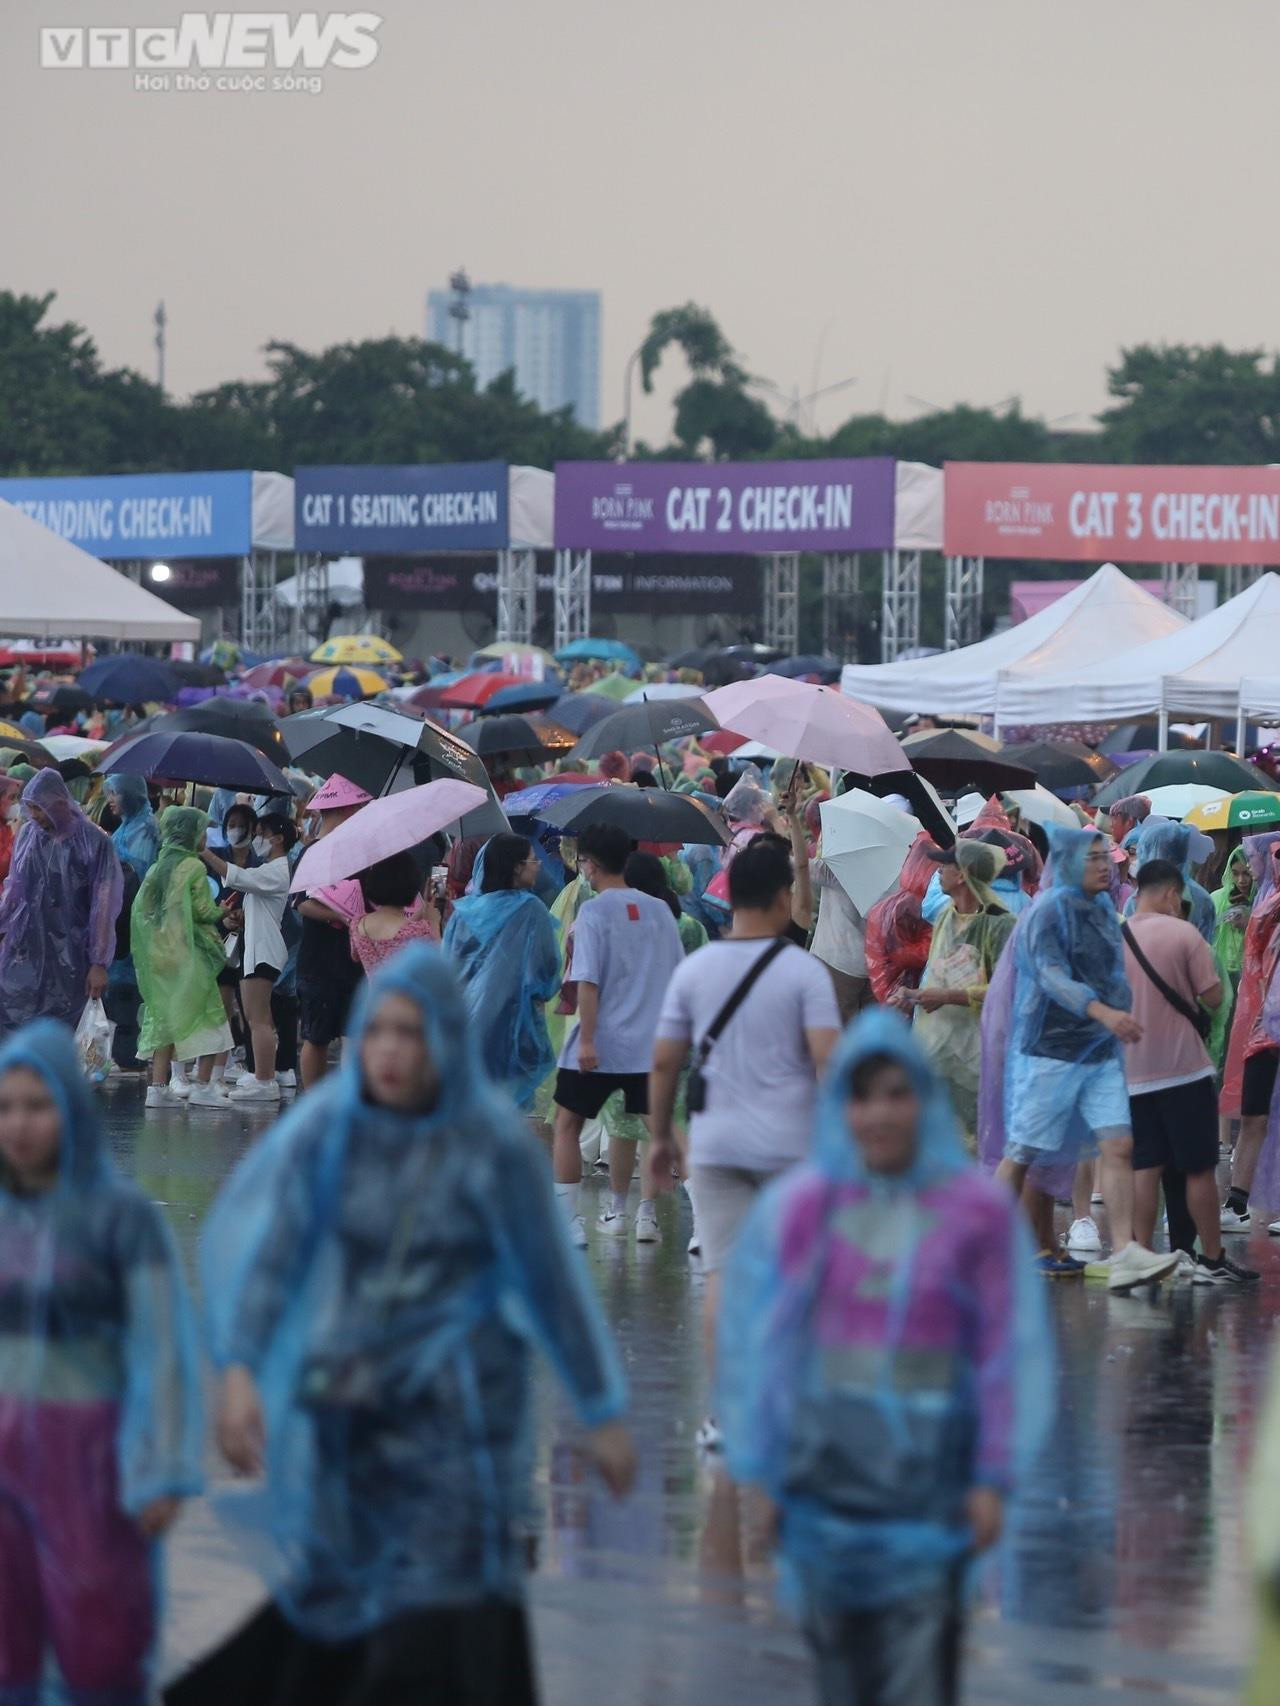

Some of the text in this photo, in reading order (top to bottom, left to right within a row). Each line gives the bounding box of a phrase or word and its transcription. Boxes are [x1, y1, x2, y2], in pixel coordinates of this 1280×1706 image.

[119, 496, 212, 539] CHECK-IN
[303, 491, 498, 527] CAT 1 SEATING CHECK-IN
[666, 485, 853, 532] CAT 2 CHECK-IN
[1068, 491, 1279, 541] CAT 3 CHECK-IN
[635, 575, 734, 593] INFORMATION
